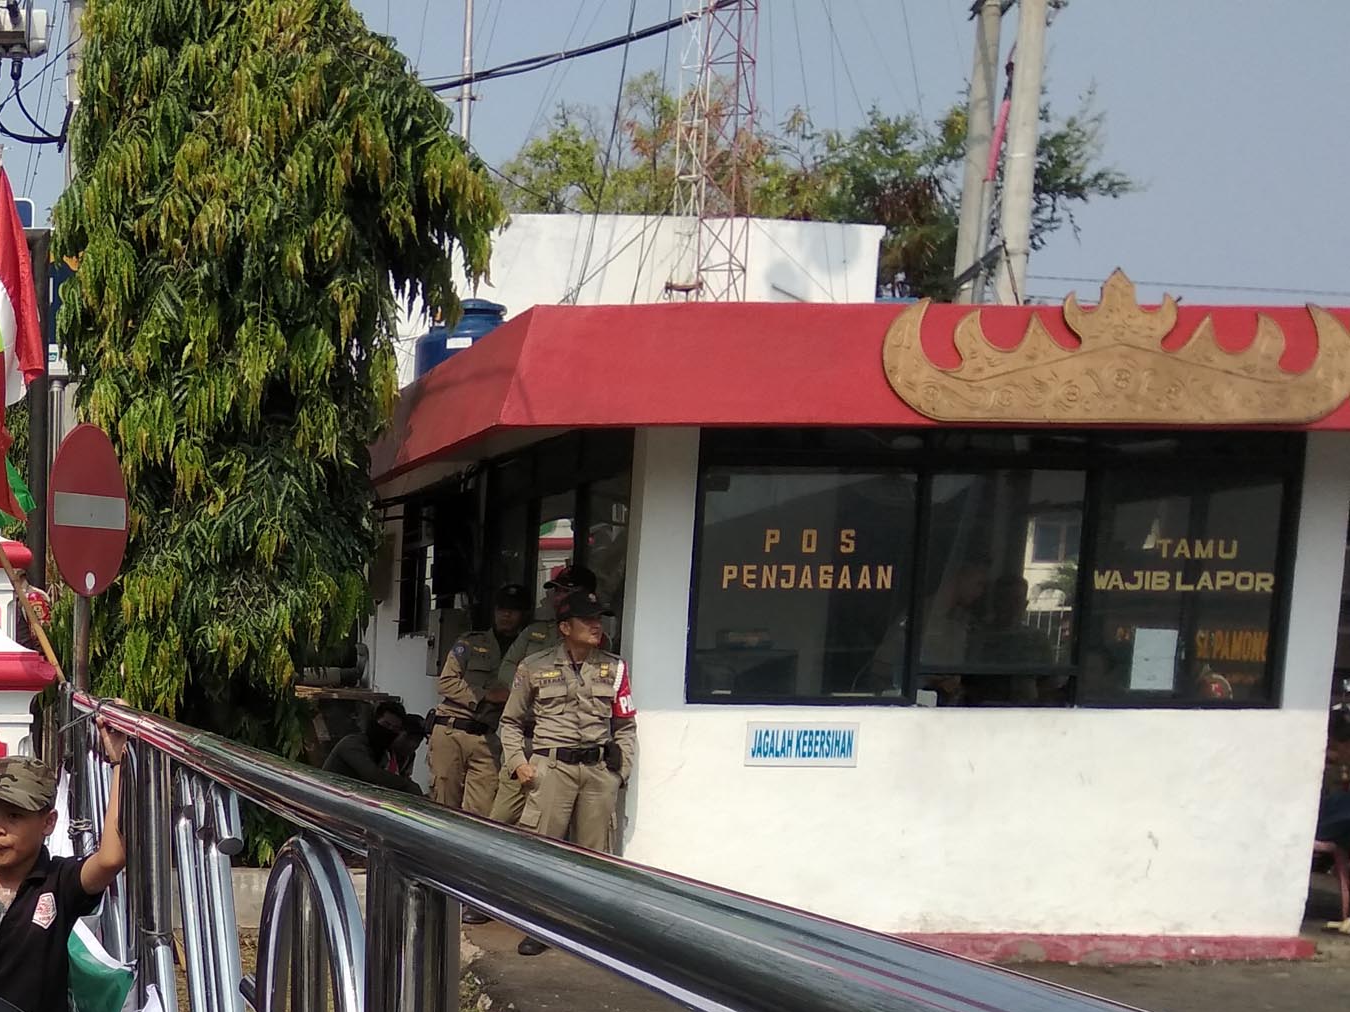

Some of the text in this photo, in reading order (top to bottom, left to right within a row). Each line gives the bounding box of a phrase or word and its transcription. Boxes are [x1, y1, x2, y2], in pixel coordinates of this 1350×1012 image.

[1156, 538, 1238, 560] TAMU
[722, 565, 893, 589] PENJAGAAN
[1093, 570, 1276, 593] WAJIB LAPOR
[751, 728, 855, 759] JAGALAH KEBERSIHAN
